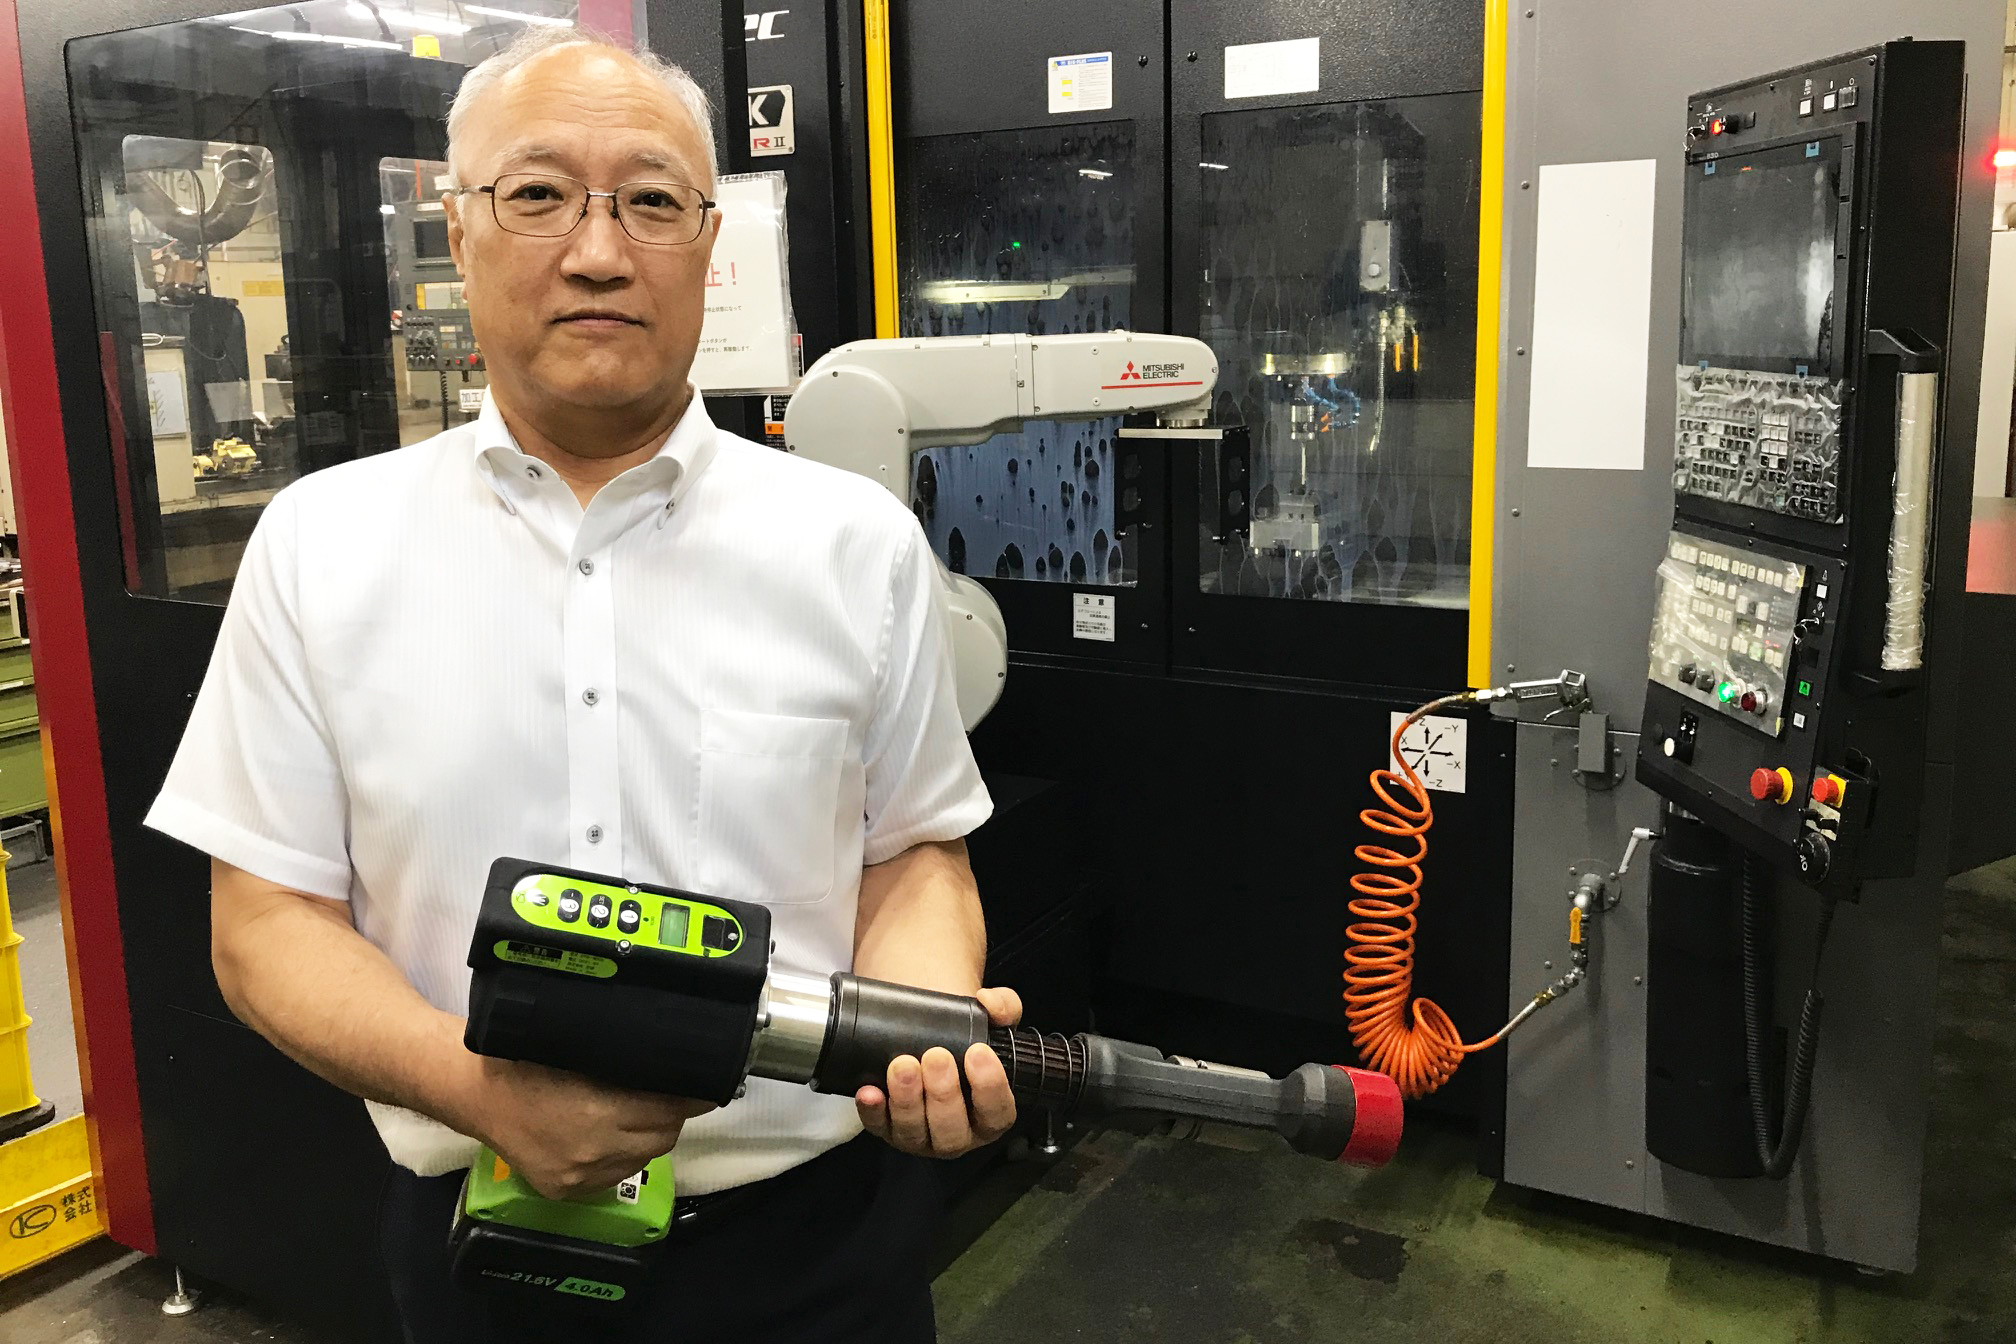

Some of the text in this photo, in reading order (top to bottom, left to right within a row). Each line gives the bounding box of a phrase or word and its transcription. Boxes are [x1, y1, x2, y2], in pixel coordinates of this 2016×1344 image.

[753, 138, 770, 149] R
[1142, 363, 1185, 372] MITSUBISHI
[1142, 371, 1179, 380] ELECTRIC
[594, 907, 606, 917] 2
[64, 1200, 93, 1222] 会社
[565, 1282, 614, 1297] 4.0Ah
